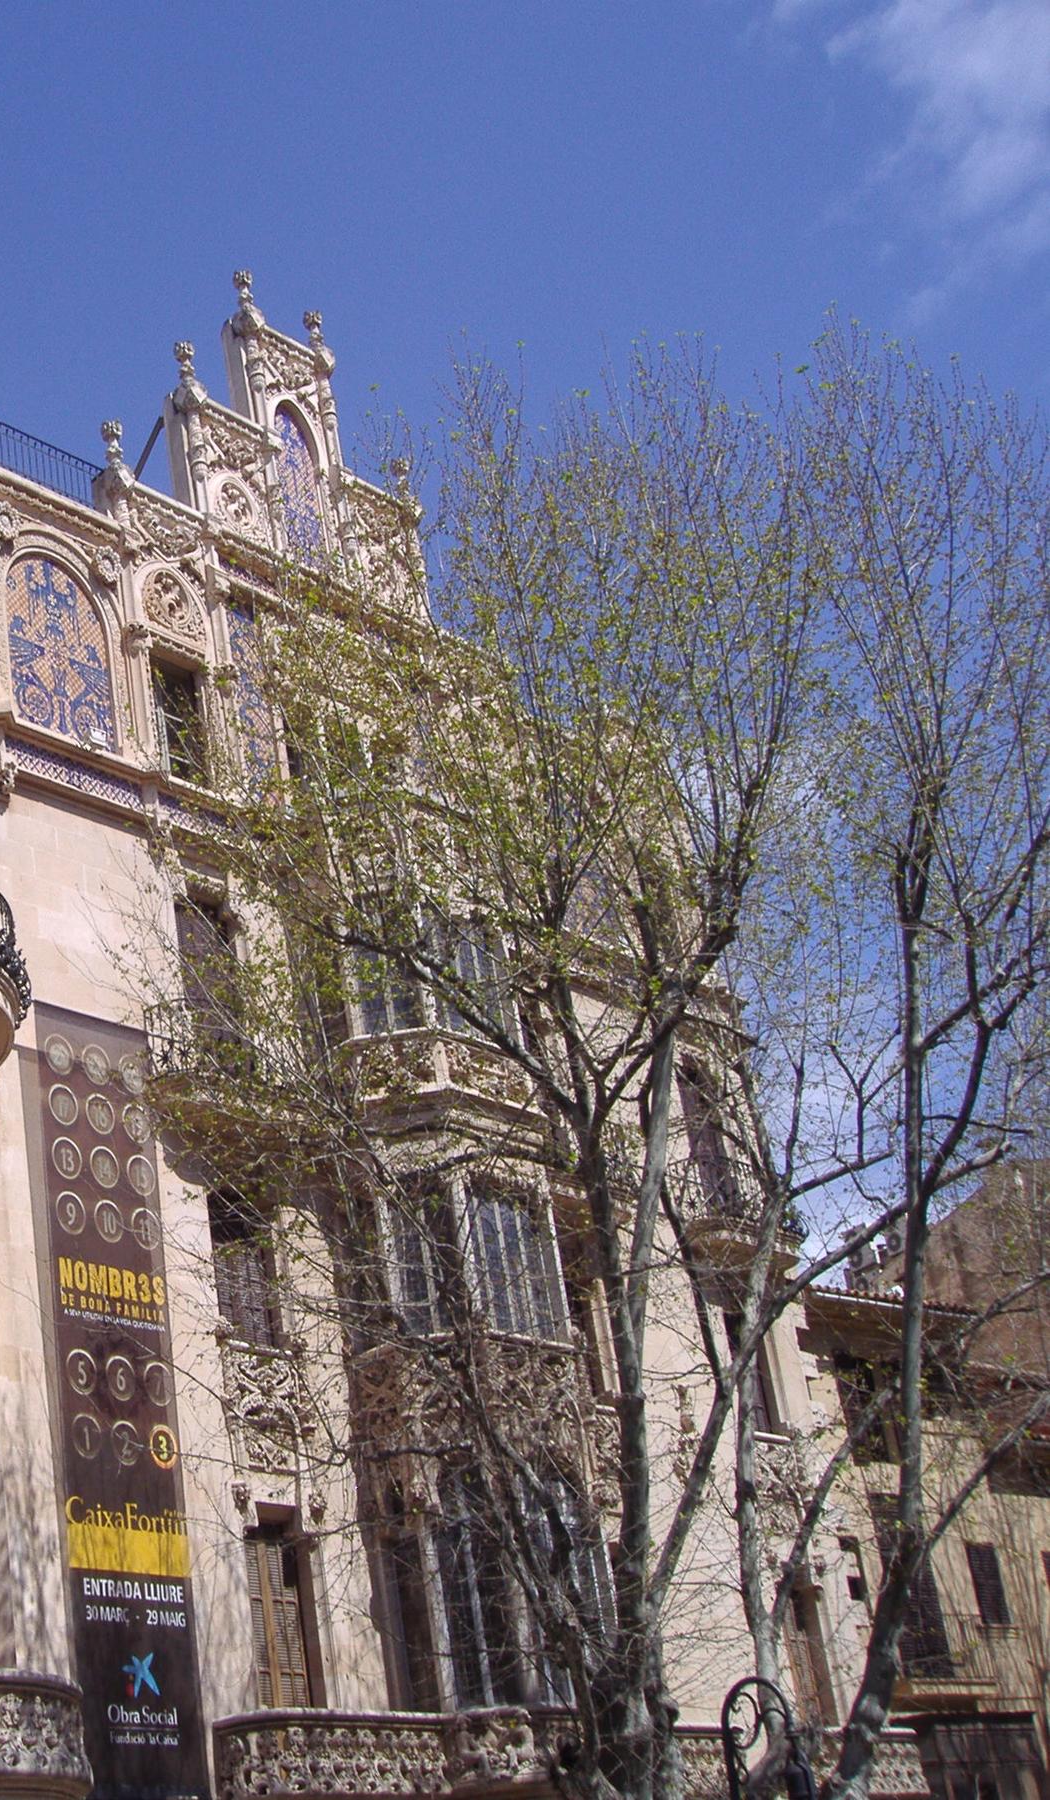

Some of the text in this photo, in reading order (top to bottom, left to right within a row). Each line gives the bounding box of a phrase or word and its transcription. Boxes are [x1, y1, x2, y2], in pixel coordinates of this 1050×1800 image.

[60, 1148, 74, 1172] 13
[66, 1202, 77, 1226] 9
[102, 1210, 117, 1235] 10
[58, 1256, 165, 1306] NOMBR3S
[61, 1292, 75, 1307] DE
[116, 1302, 165, 1324] FAMILIA
[78, 1359, 88, 1385] 5
[116, 1367, 126, 1391] 6
[158, 1434, 168, 1460] 3
[65, 1496, 188, 1536] CaixaForum
[83, 1577, 184, 1603] ENTRADA LLIURE
[85, 1605, 99, 1621] 30
[146, 1609, 158, 1625] 29
[159, 1610, 187, 1628] MAIG
[107, 1704, 179, 1726] Obra Social
